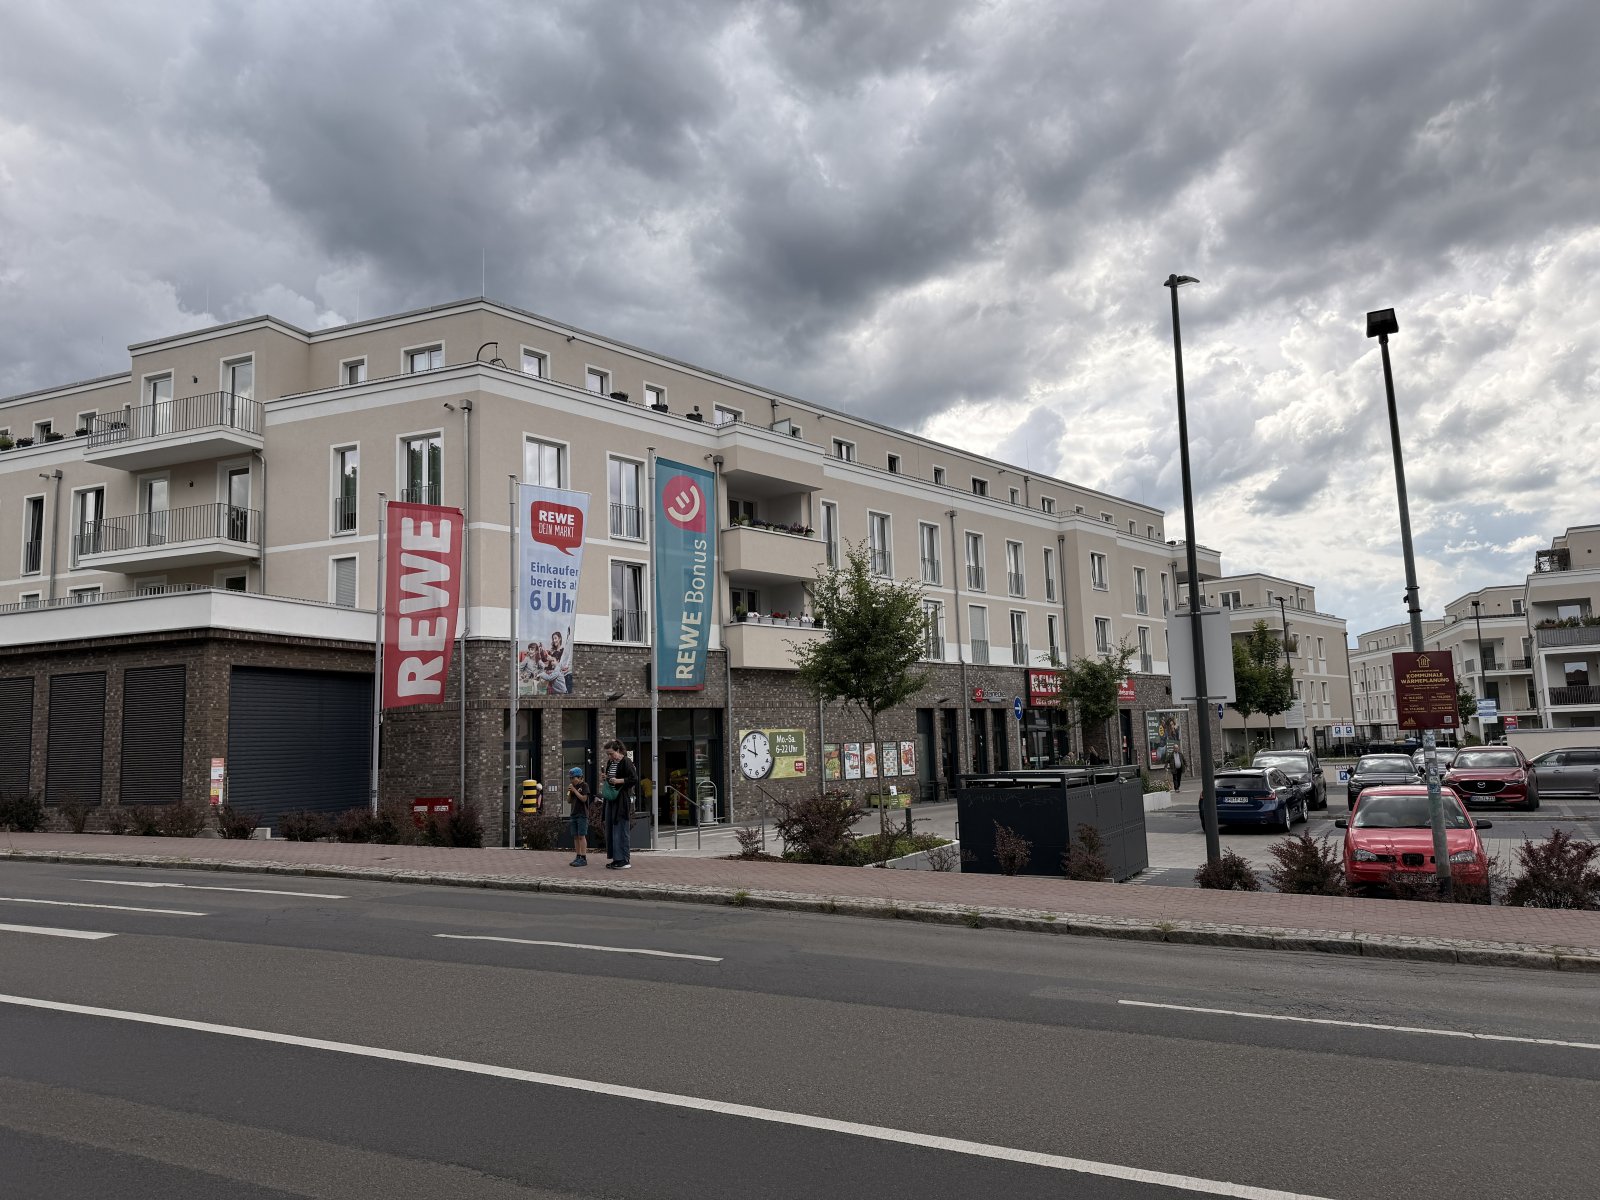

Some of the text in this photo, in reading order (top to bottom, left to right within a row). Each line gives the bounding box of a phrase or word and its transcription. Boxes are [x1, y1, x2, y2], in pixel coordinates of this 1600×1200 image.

[538, 510, 574, 526] REWE
[538, 522, 574, 538] DEIN MARKT
[530, 576, 566, 590] bereits
[398, 517, 452, 697] REWE
[530, 590, 542, 610] 6
[676, 540, 707, 678] REWE Bonus
[776, 734, 796, 743] Mo.-Sa.
